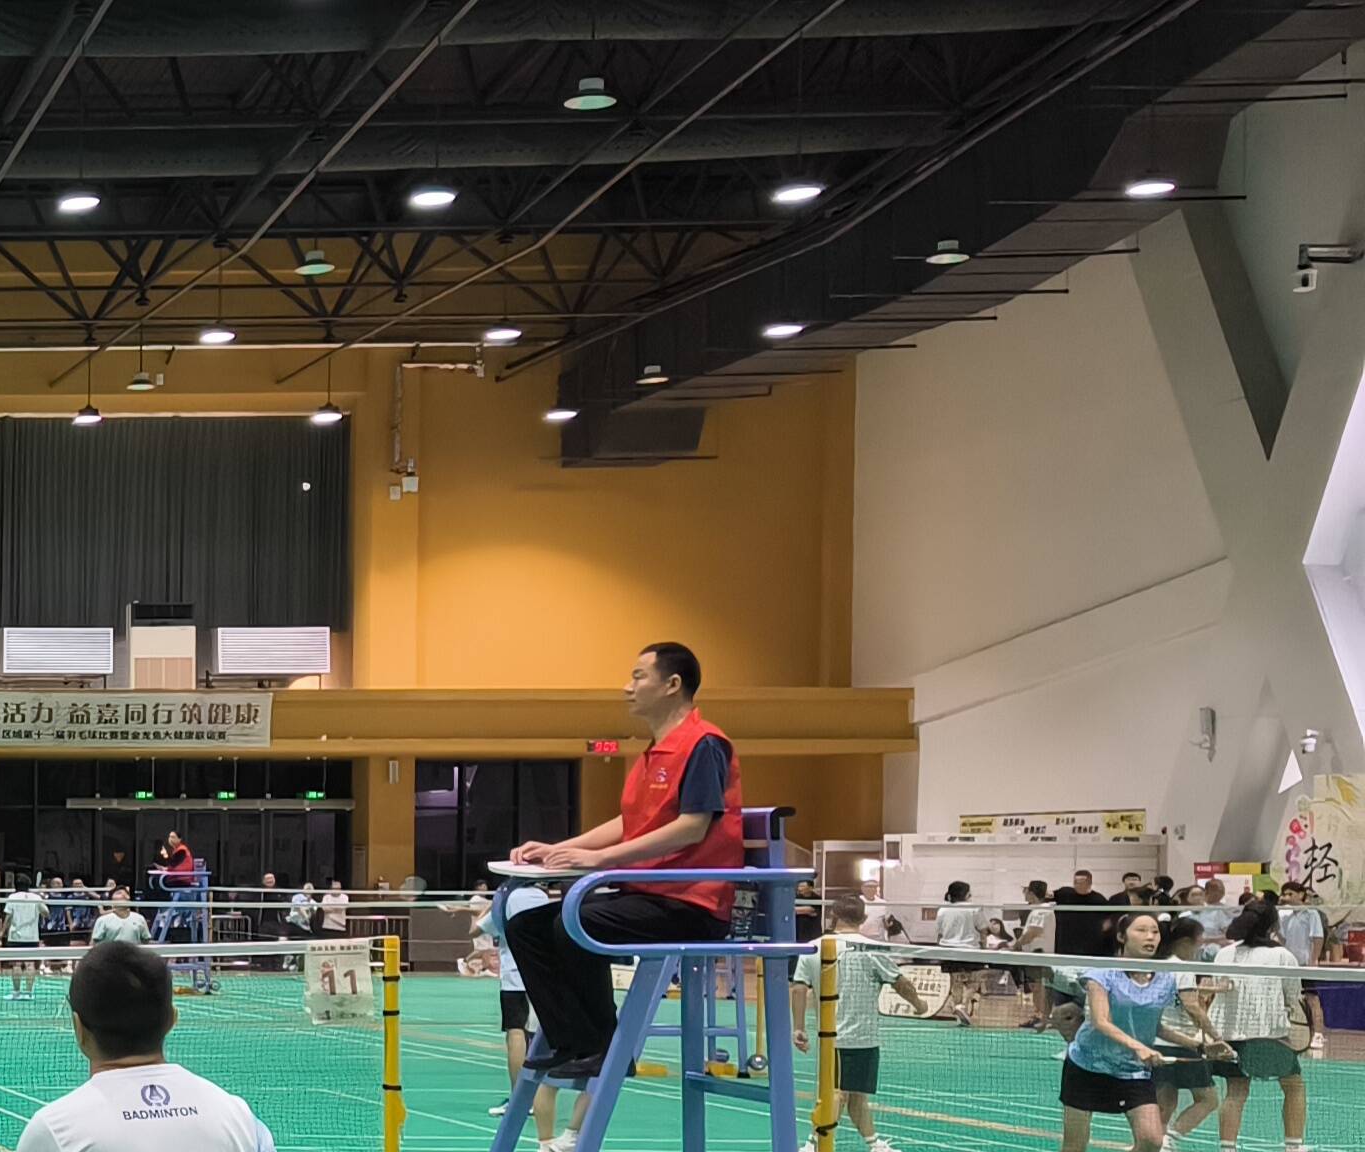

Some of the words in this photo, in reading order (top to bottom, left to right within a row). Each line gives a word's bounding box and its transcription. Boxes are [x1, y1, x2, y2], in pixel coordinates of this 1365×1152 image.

[68, 702, 261, 726] 益嘉同行筑健康
[1300, 837, 1340, 893] 轻
[321, 969, 358, 995] 11
[122, 1106, 199, 1121] BADMINTON
